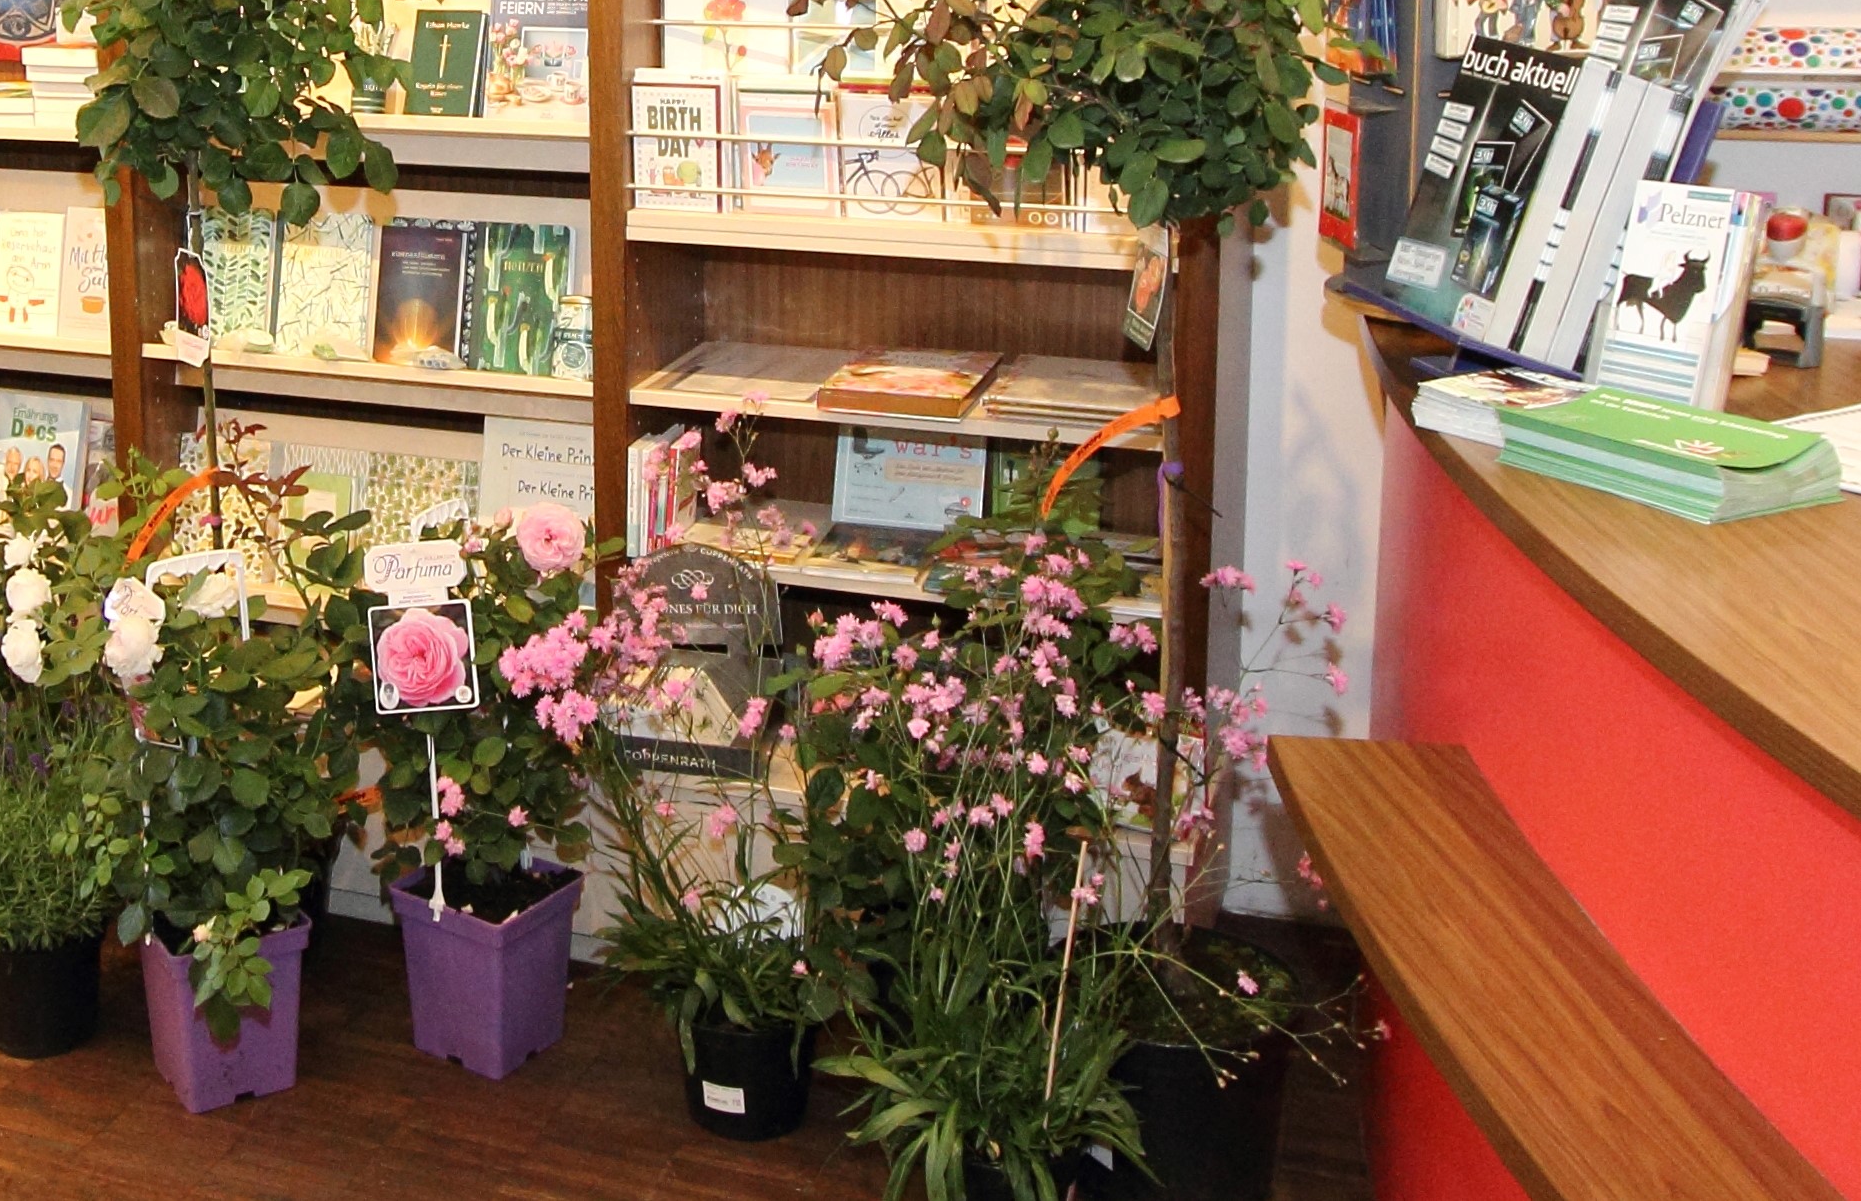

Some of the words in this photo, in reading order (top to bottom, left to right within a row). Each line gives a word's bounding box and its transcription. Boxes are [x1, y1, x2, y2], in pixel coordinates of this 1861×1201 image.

[499, 1, 545, 15] FEIERN
[1462, 33, 1510, 78] buch
[1510, 56, 1581, 95] aktuell
[647, 105, 702, 132] BIRTH
[657, 136, 691, 159] DAY
[1658, 202, 1727, 230] Pelzner
[503, 260, 544, 274] NOTIZEN
[13, 407, 59, 423] Ernährungs
[11, 417, 58, 443] DOCS
[502, 443, 522, 458] Der
[526, 444, 563, 463] Kleine
[567, 447, 594, 466] Prin
[518, 480, 537, 494] Der
[539, 481, 575, 500] Kleine
[578, 484, 595, 501] Pri
[373, 553, 453, 585] Parfuma
[696, 602, 721, 615] FÜR
[724, 603, 758, 616] DICH
[624, 749, 717, 770] COPPENRATH
